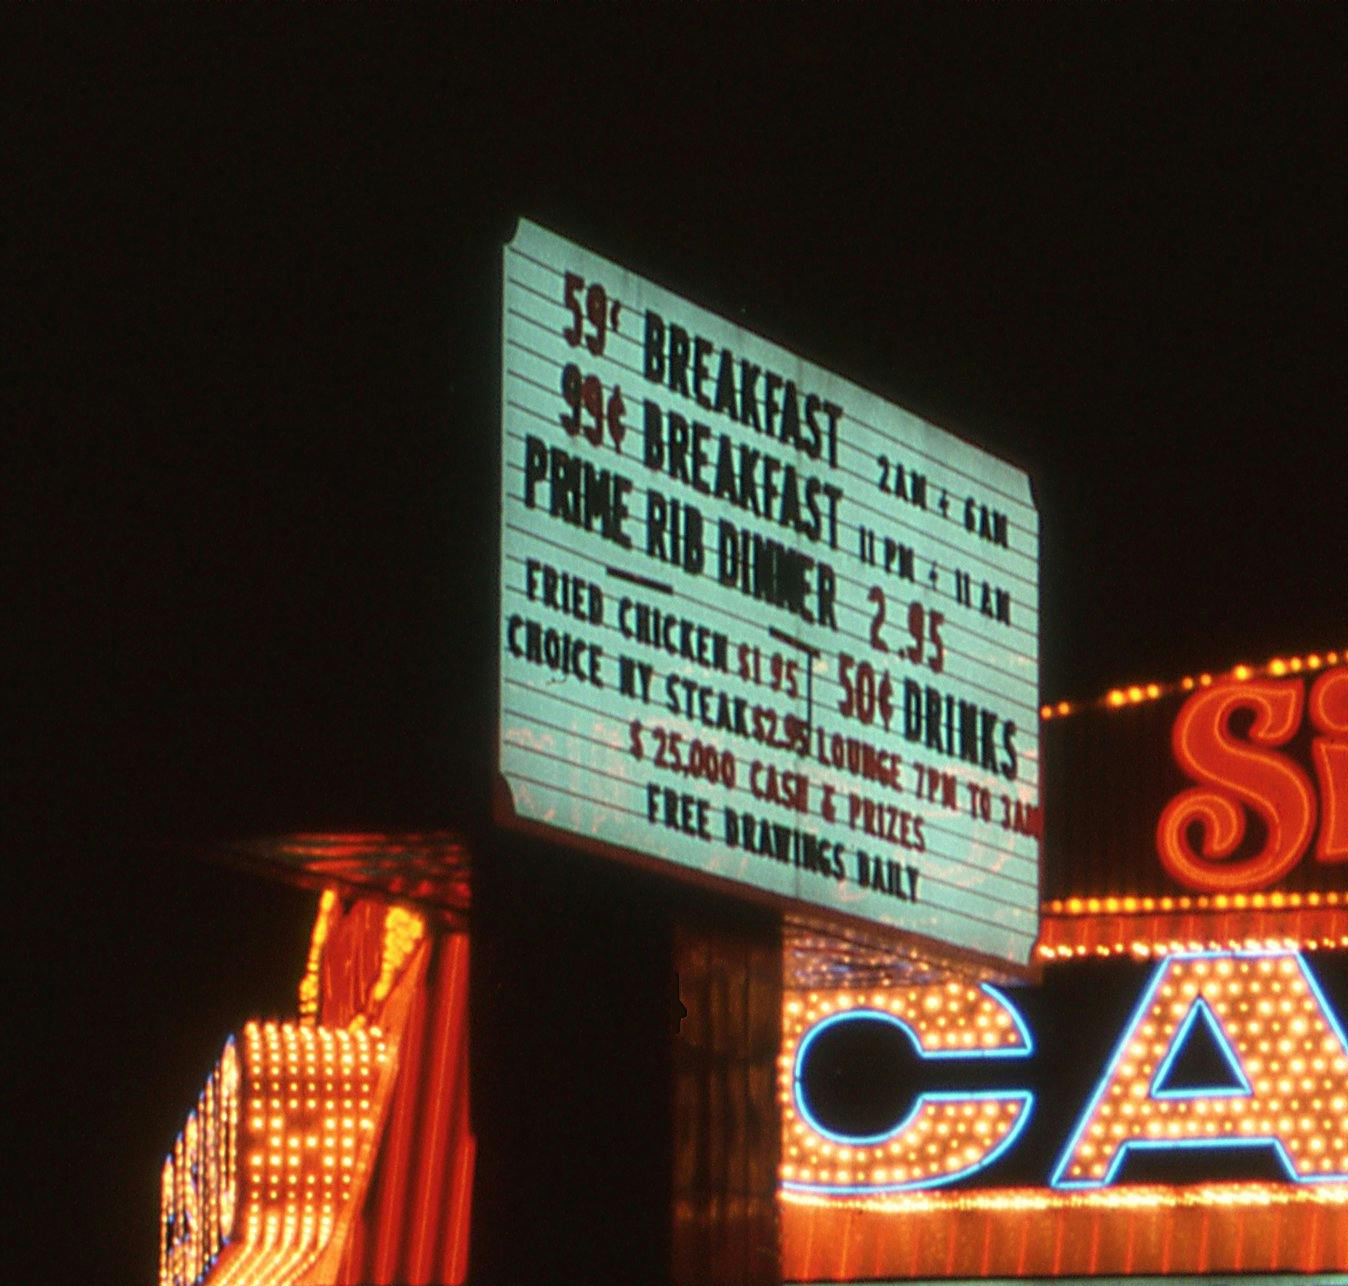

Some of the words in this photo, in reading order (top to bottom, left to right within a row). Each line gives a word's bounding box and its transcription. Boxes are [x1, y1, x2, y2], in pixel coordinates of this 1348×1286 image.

[643, 308, 843, 469] BREAKFAST
[559, 362, 627, 454] 99¢
[643, 397, 843, 549] BREAKFAST
[524, 434, 633, 550] PRIME
[646, 488, 705, 576] RIB
[718, 516, 839, 632] DINNER
[507, 614, 603, 689] CHOICE
[619, 653, 654, 705] NY
[666, 673, 750, 739] STEAK
[525, 557, 604, 626] FRIED
[618, 596, 730, 673] CHICKEN
[867, 585, 945, 674] 2.95
[817, 725, 903, 794] LOUNGE
[912, 761, 957, 812] 7PM
[966, 781, 991, 823] TO
[837, 652, 894, 733] 50¢
[903, 675, 1018, 782] DRINKS
[647, 781, 713, 842] FREE
[724, 805, 846, 882] DRAWINGS
[857, 850, 920, 904] DAILY
[750, 760, 809, 815] CASH
[849, 794, 926, 854] PRIZES
